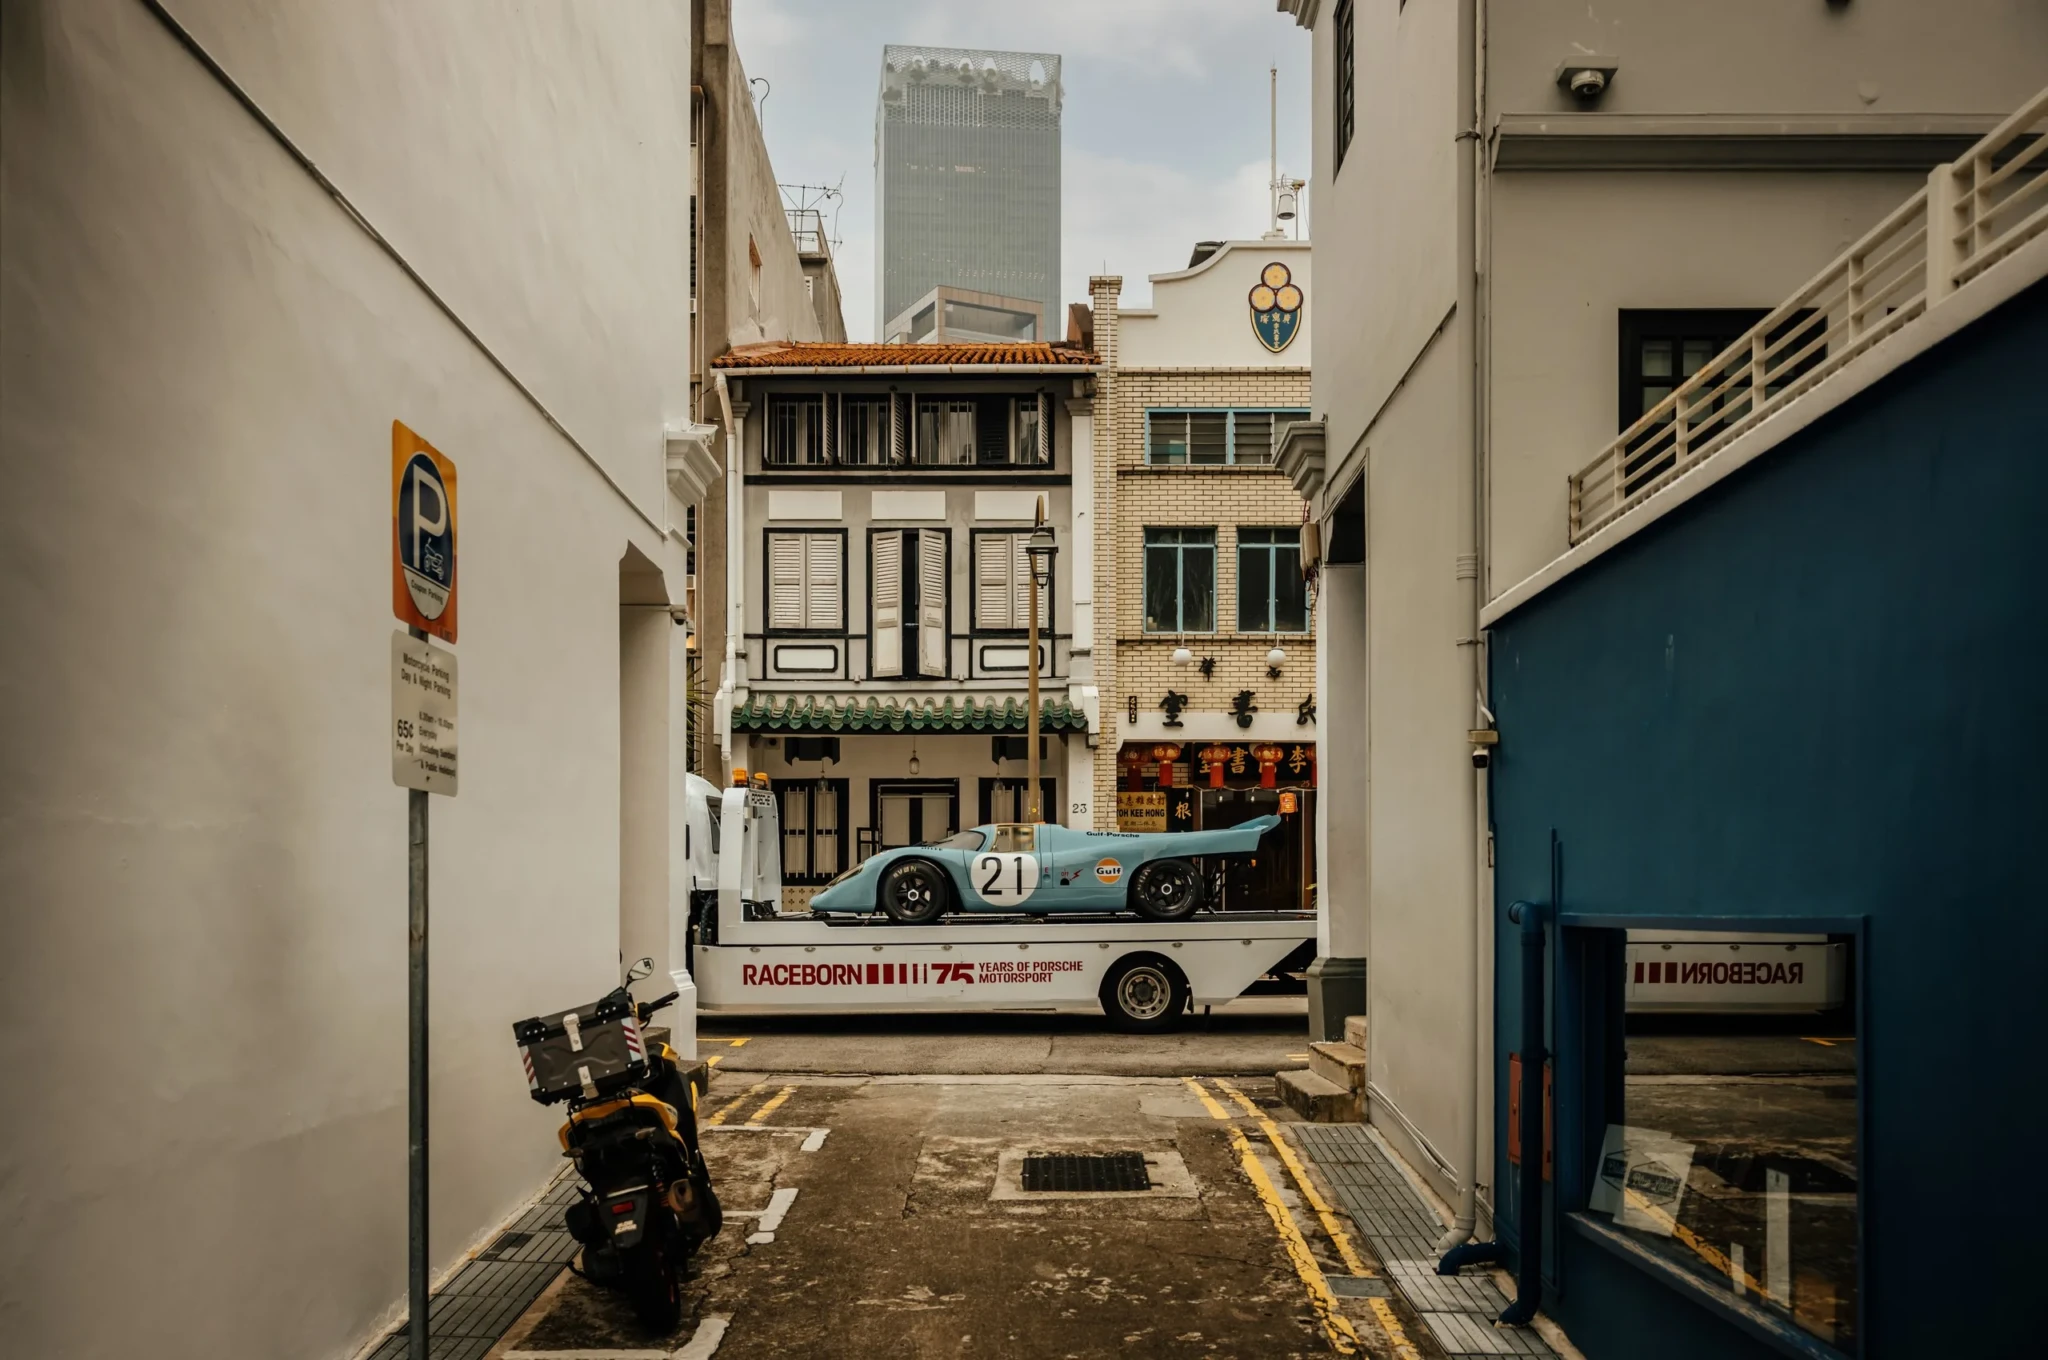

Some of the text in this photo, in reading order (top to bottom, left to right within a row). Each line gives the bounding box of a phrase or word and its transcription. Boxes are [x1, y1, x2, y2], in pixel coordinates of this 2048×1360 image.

[413, 464, 446, 570] P
[432, 664, 449, 684] Parking
[434, 680, 451, 700] Parking
[1072, 803, 1087, 814] 23
[1131, 809, 1143, 817] KEE
[1146, 809, 1165, 817] HONG
[981, 857, 1022, 896] 21
[1096, 867, 1121, 875] Gulf
[743, 964, 862, 985] RACEBORN
[931, 963, 974, 984] 75
[979, 961, 1083, 972] YEARS OF PORSCHE
[979, 973, 1053, 983] MOTORSPORT
